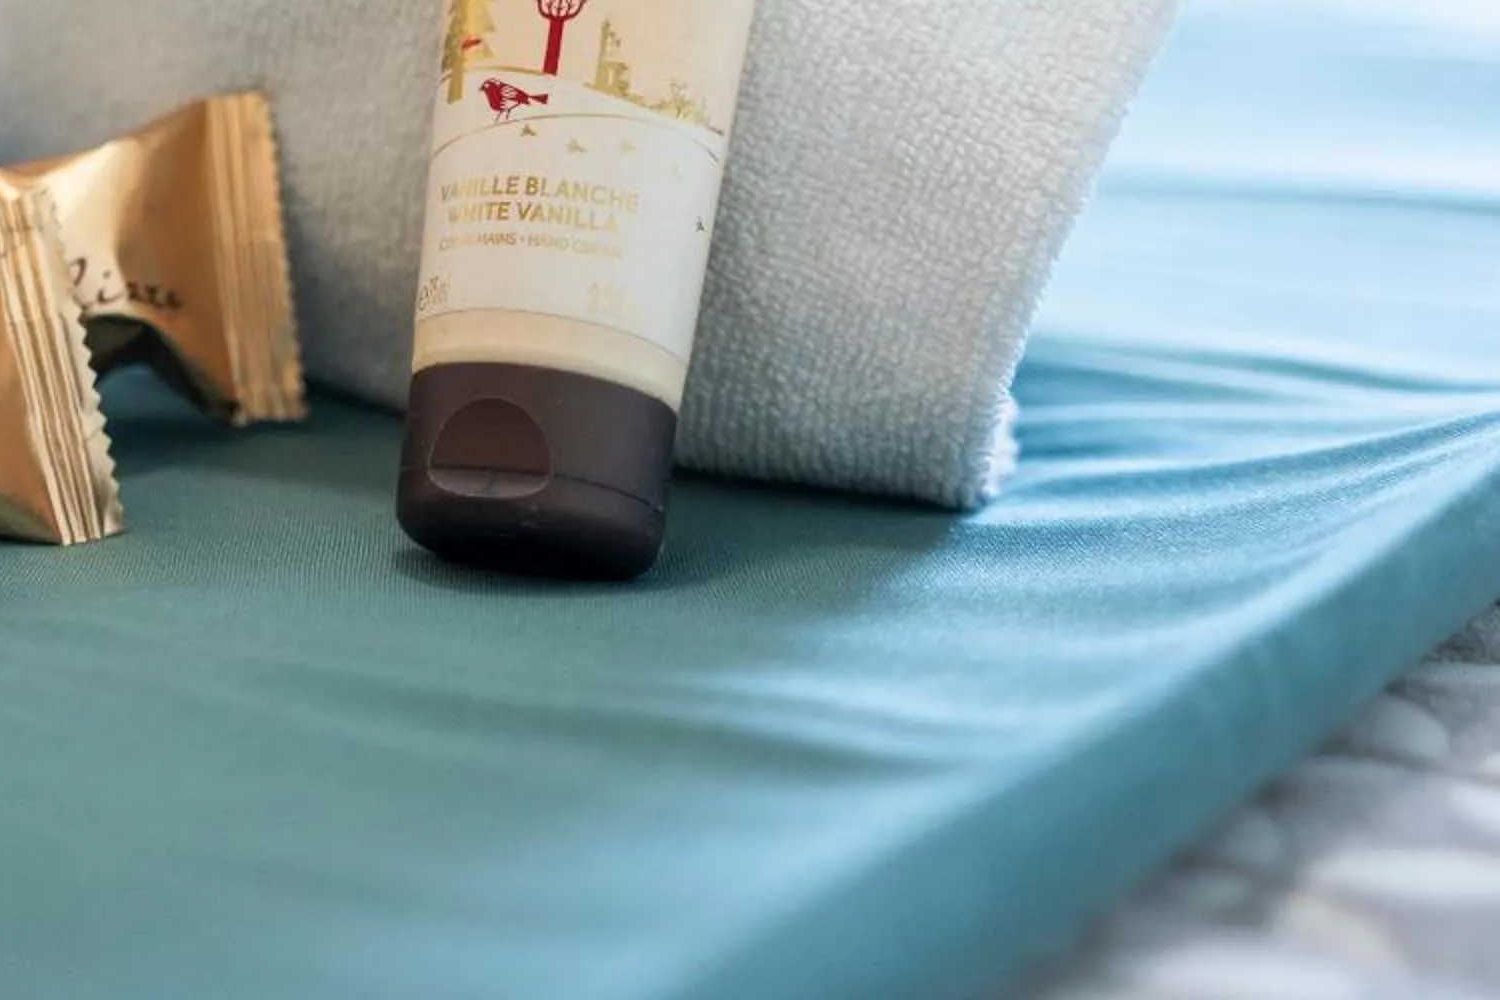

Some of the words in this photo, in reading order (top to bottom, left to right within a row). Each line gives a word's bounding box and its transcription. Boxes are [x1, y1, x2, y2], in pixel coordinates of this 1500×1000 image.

[440, 175, 520, 202] VANILLE
[525, 176, 641, 214] BLANCHE
[448, 201, 511, 223] WHITE
[517, 202, 619, 235] VANILLA
